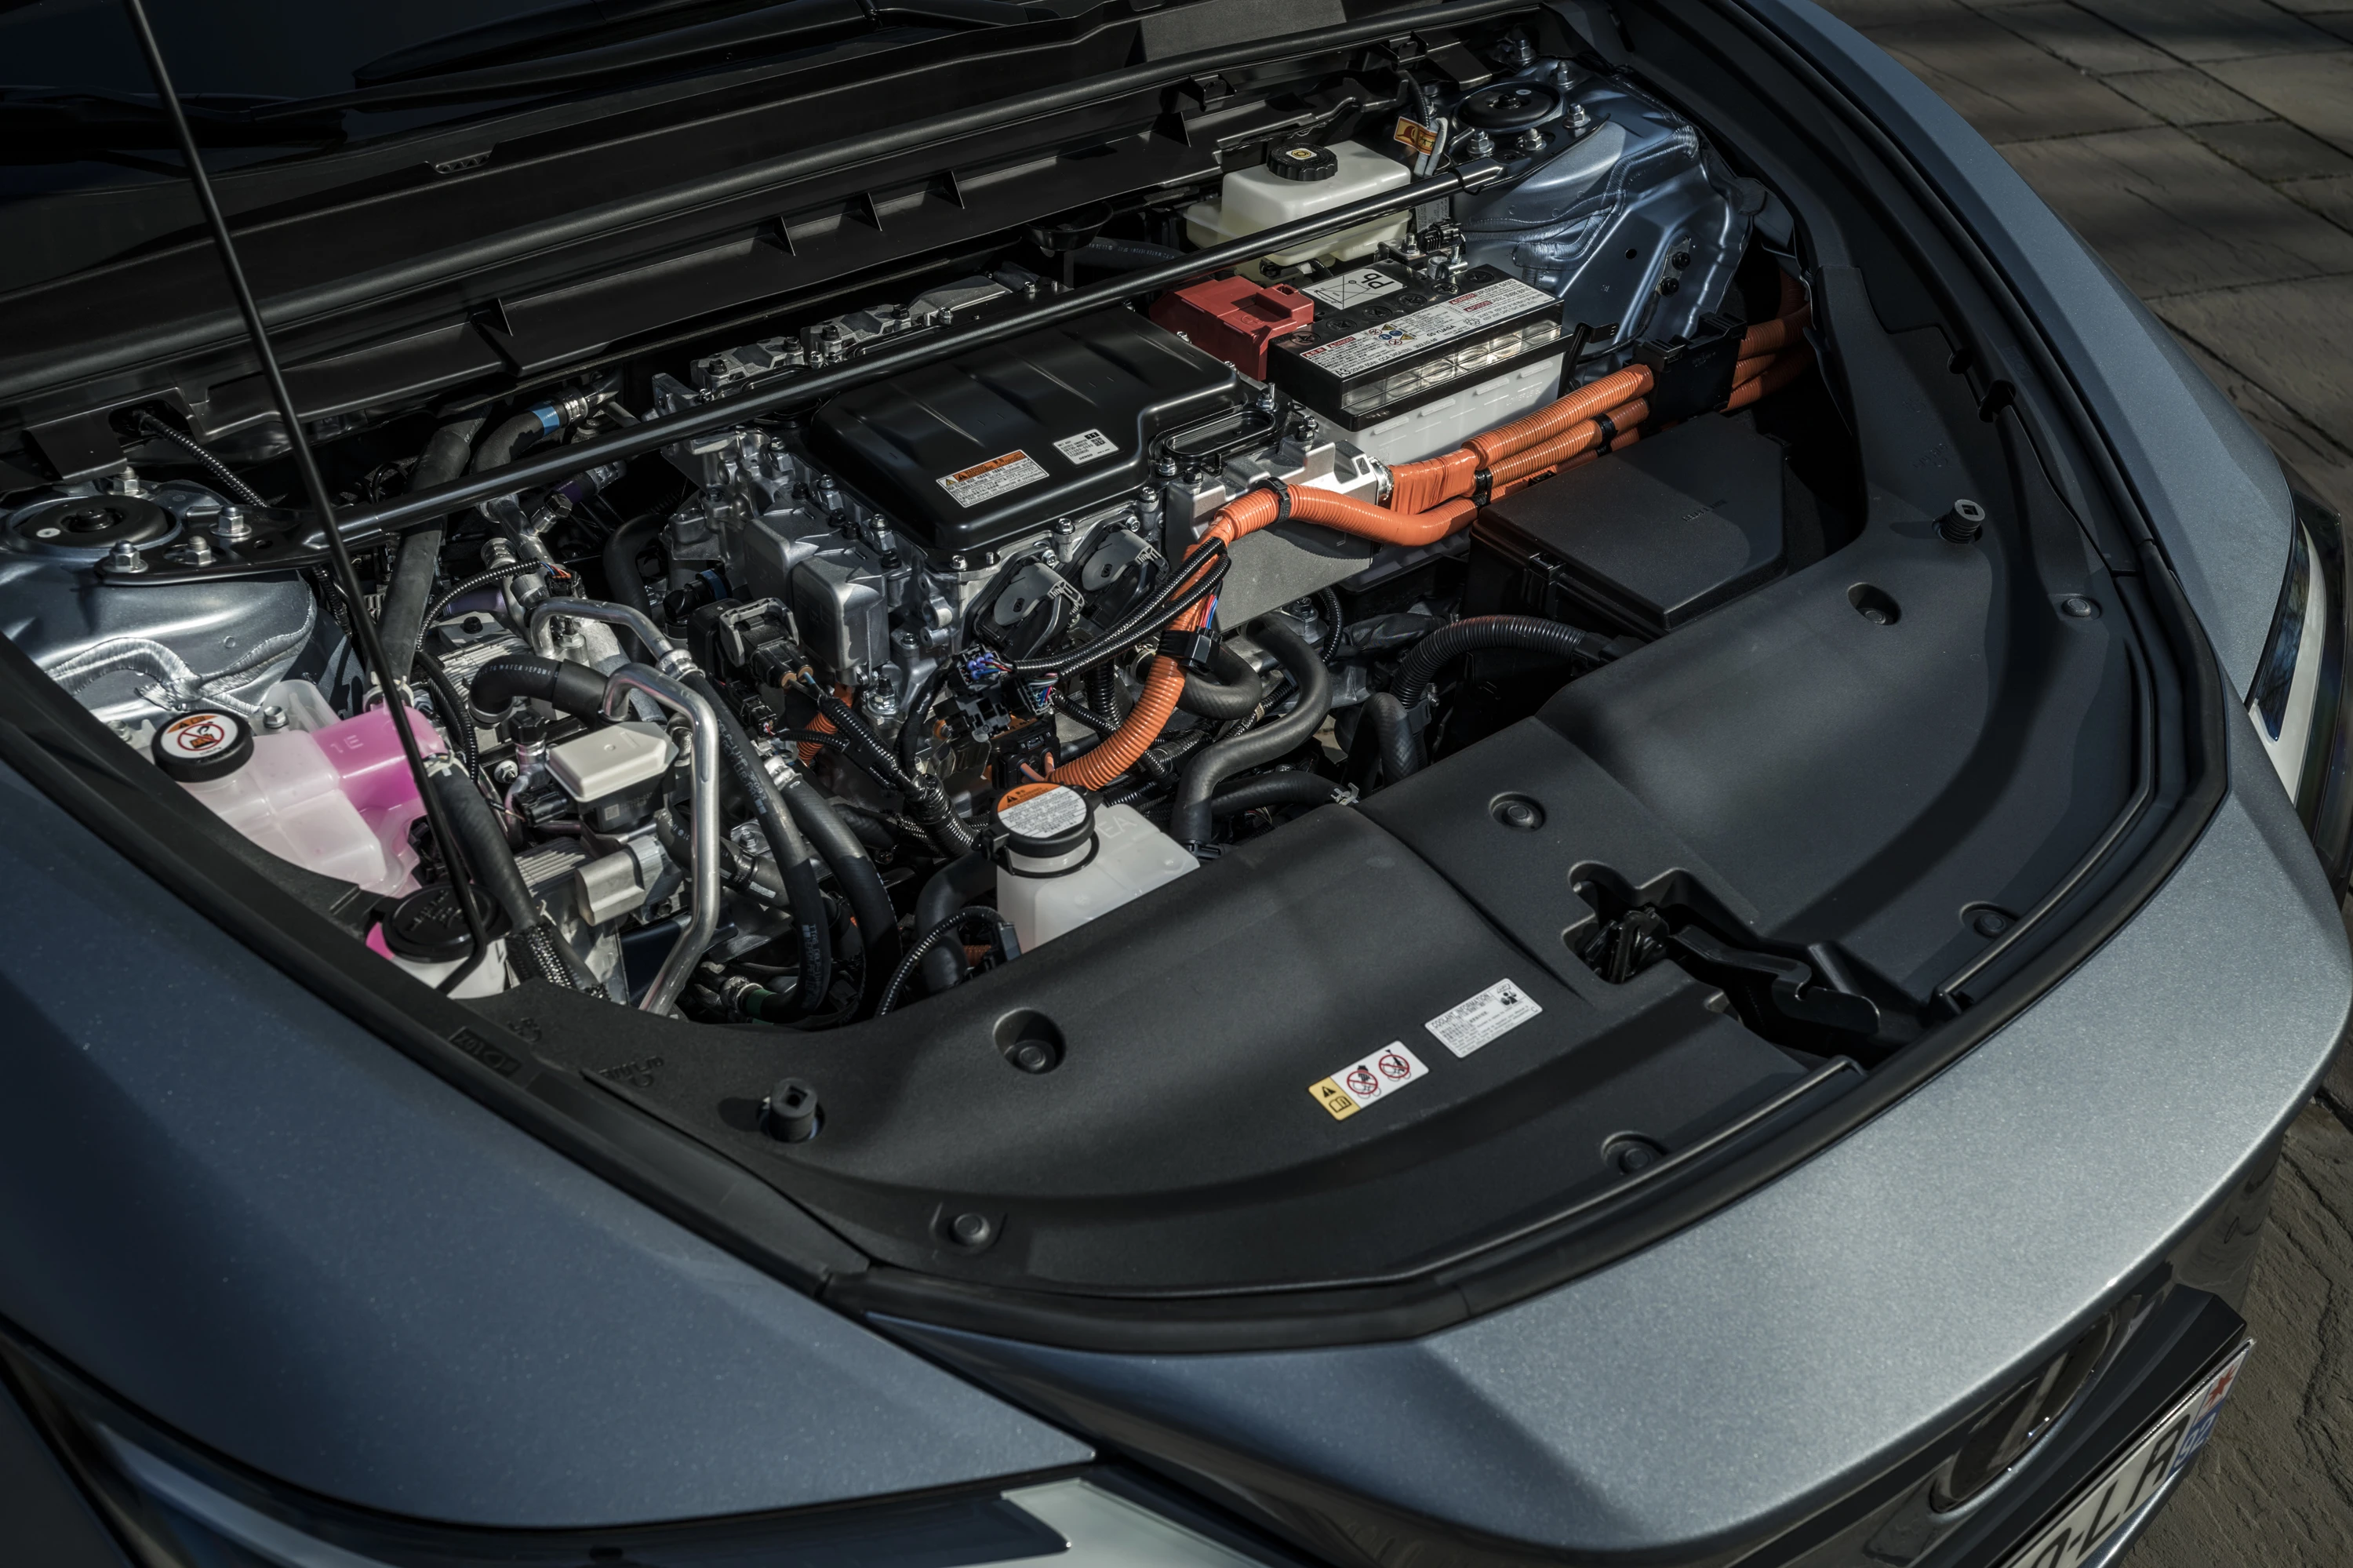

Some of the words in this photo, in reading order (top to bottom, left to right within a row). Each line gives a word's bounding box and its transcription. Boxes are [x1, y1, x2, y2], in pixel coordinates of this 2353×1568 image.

[1361, 273, 1395, 289] Pb
[1475, 285, 1499, 295] EXPLOSIVE
[1498, 279, 1516, 288] GASES
[1435, 325, 1457, 337] YUASA
[1337, 368, 1351, 377] A3
[1350, 365, 1365, 373] 20HR
[1431, 1011, 1454, 1028] COOLANT
[1454, 993, 1491, 1015] INFORMATION
